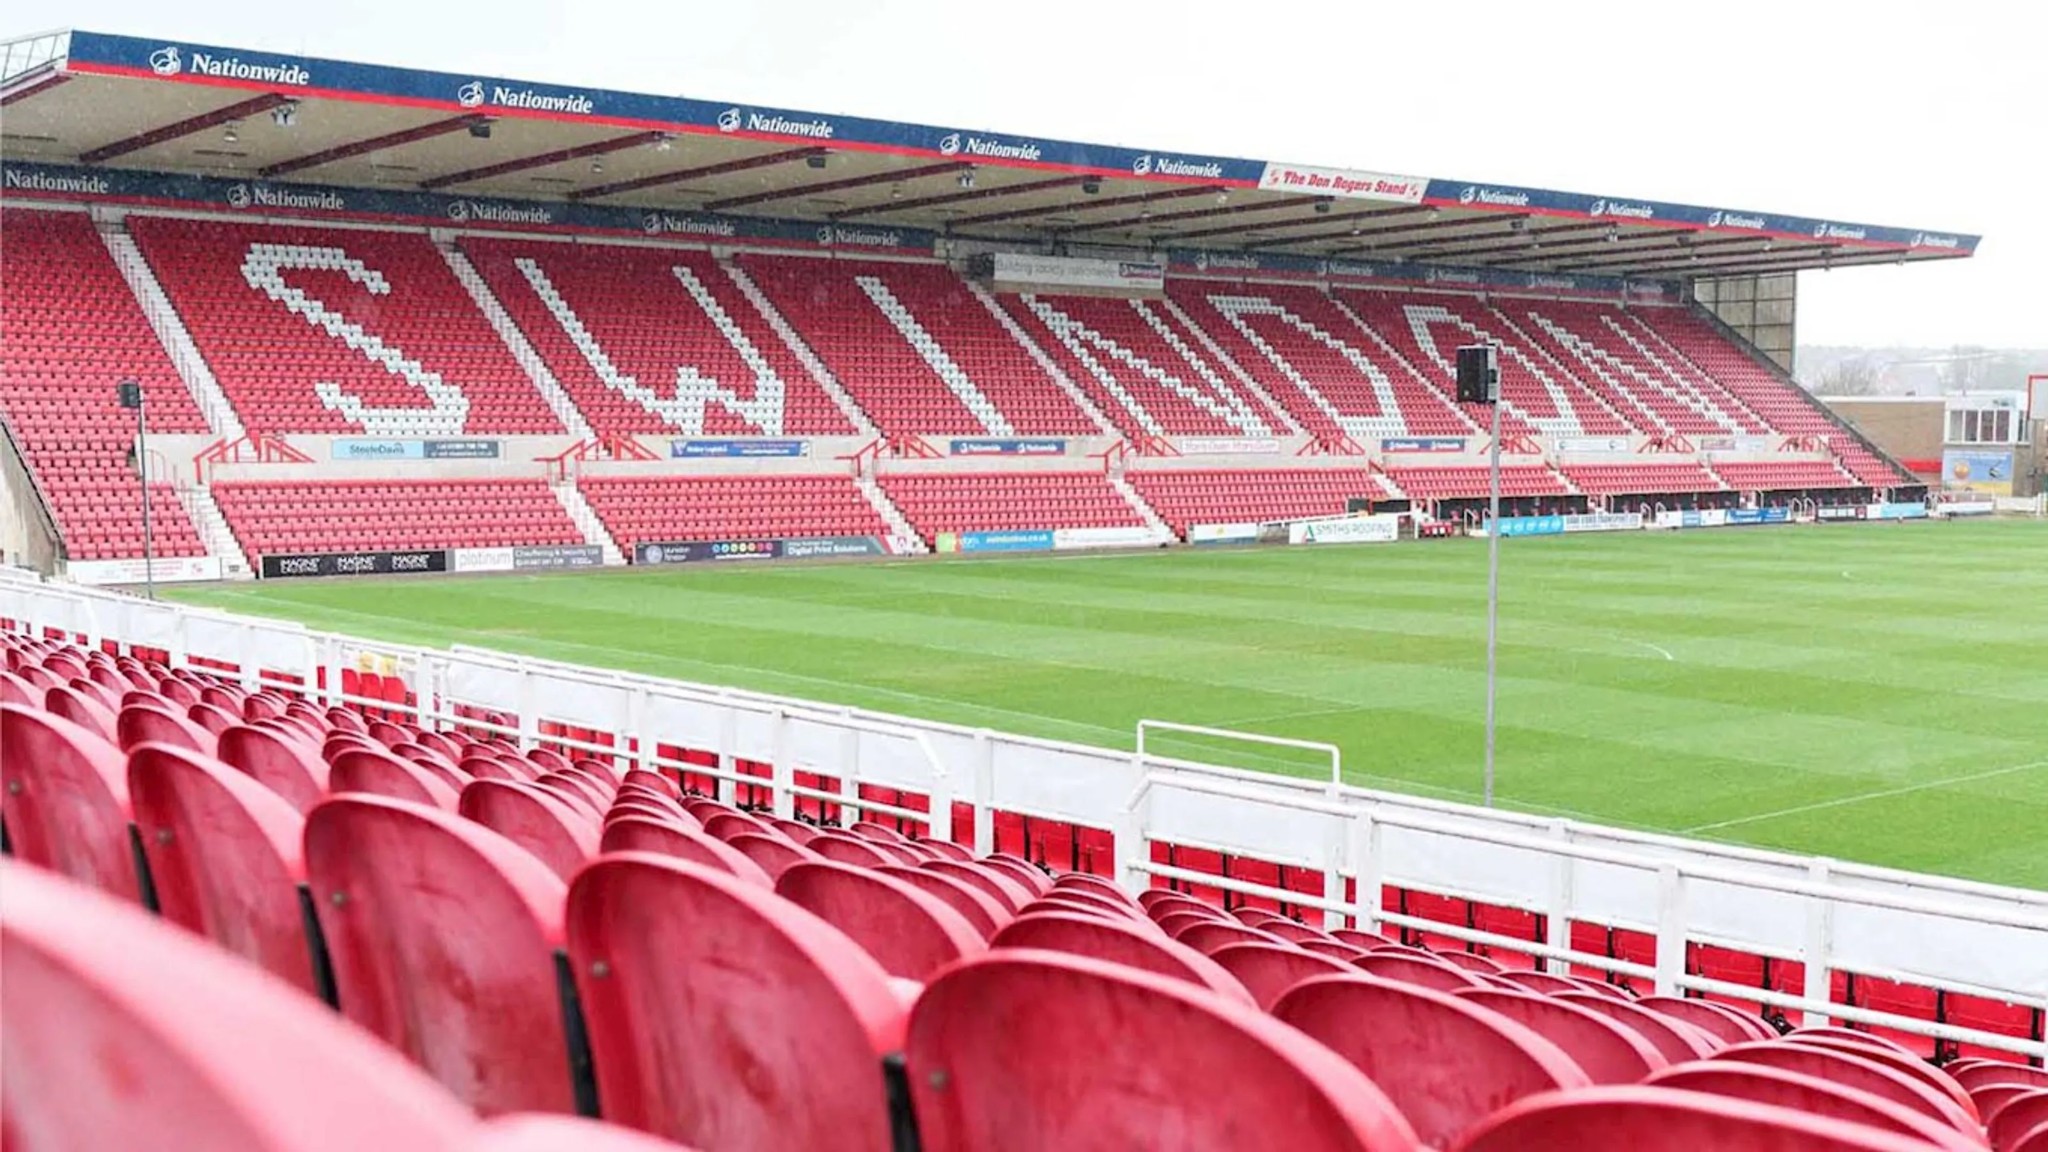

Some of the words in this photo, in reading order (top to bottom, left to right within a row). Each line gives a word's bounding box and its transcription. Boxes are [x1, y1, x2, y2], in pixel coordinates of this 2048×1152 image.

[190, 54, 310, 86] Nationwide
[492, 86, 593, 114] Nationwide
[748, 113, 833, 138] Nationwide
[965, 137, 1041, 161] Nationwide
[1154, 158, 1223, 178] Nationwide
[5, 170, 109, 194] Nationwide
[1283, 171, 1304, 185] The
[1307, 173, 1329, 188] Don
[1332, 176, 1372, 193] Rogers
[1374, 180, 1408, 195] Stand
[253, 188, 345, 210] Nationwide
[1476, 189, 1530, 206] Nationwide
[469, 204, 552, 224] Nationwide
[1606, 202, 1654, 219] Nationwide
[663, 216, 735, 236] Nationwide
[835, 228, 900, 247] Nationwide
[1316, 524, 1350, 534] SMITHS
